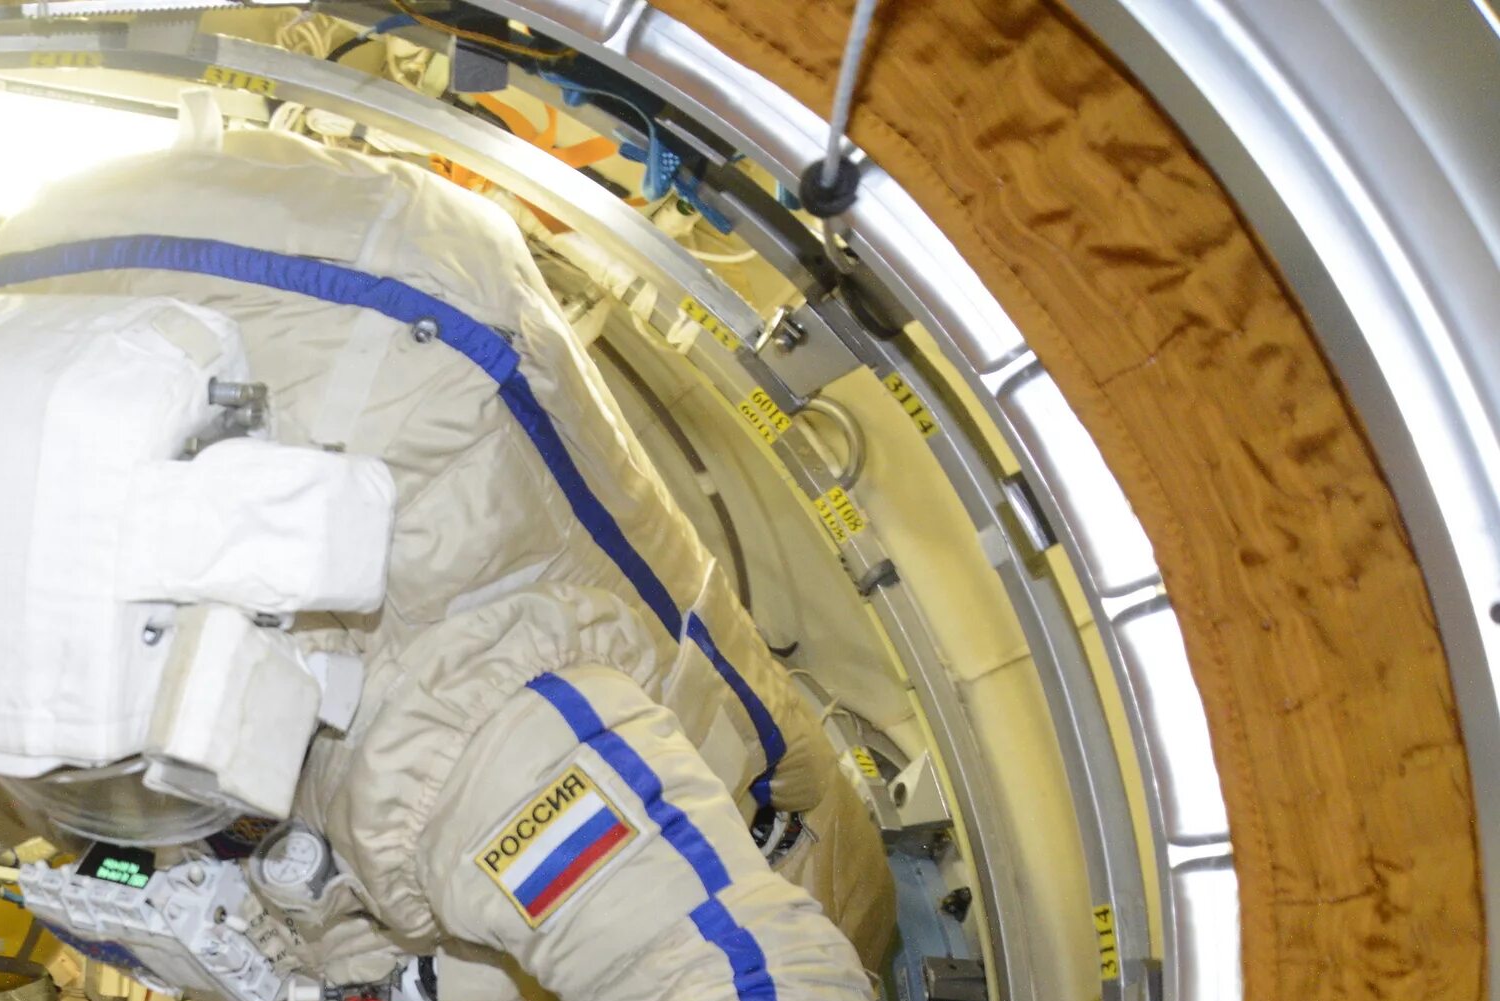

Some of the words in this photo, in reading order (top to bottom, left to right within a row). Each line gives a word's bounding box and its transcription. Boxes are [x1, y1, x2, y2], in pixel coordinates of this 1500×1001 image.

[211, 67, 270, 92] 3113
[741, 405, 771, 441] 3109
[752, 391, 790, 431] 3109
[884, 375, 934, 435] 3114
[832, 489, 863, 532] 3108
[484, 773, 587, 873] РОССИЯ
[1094, 907, 1117, 974] 3114
